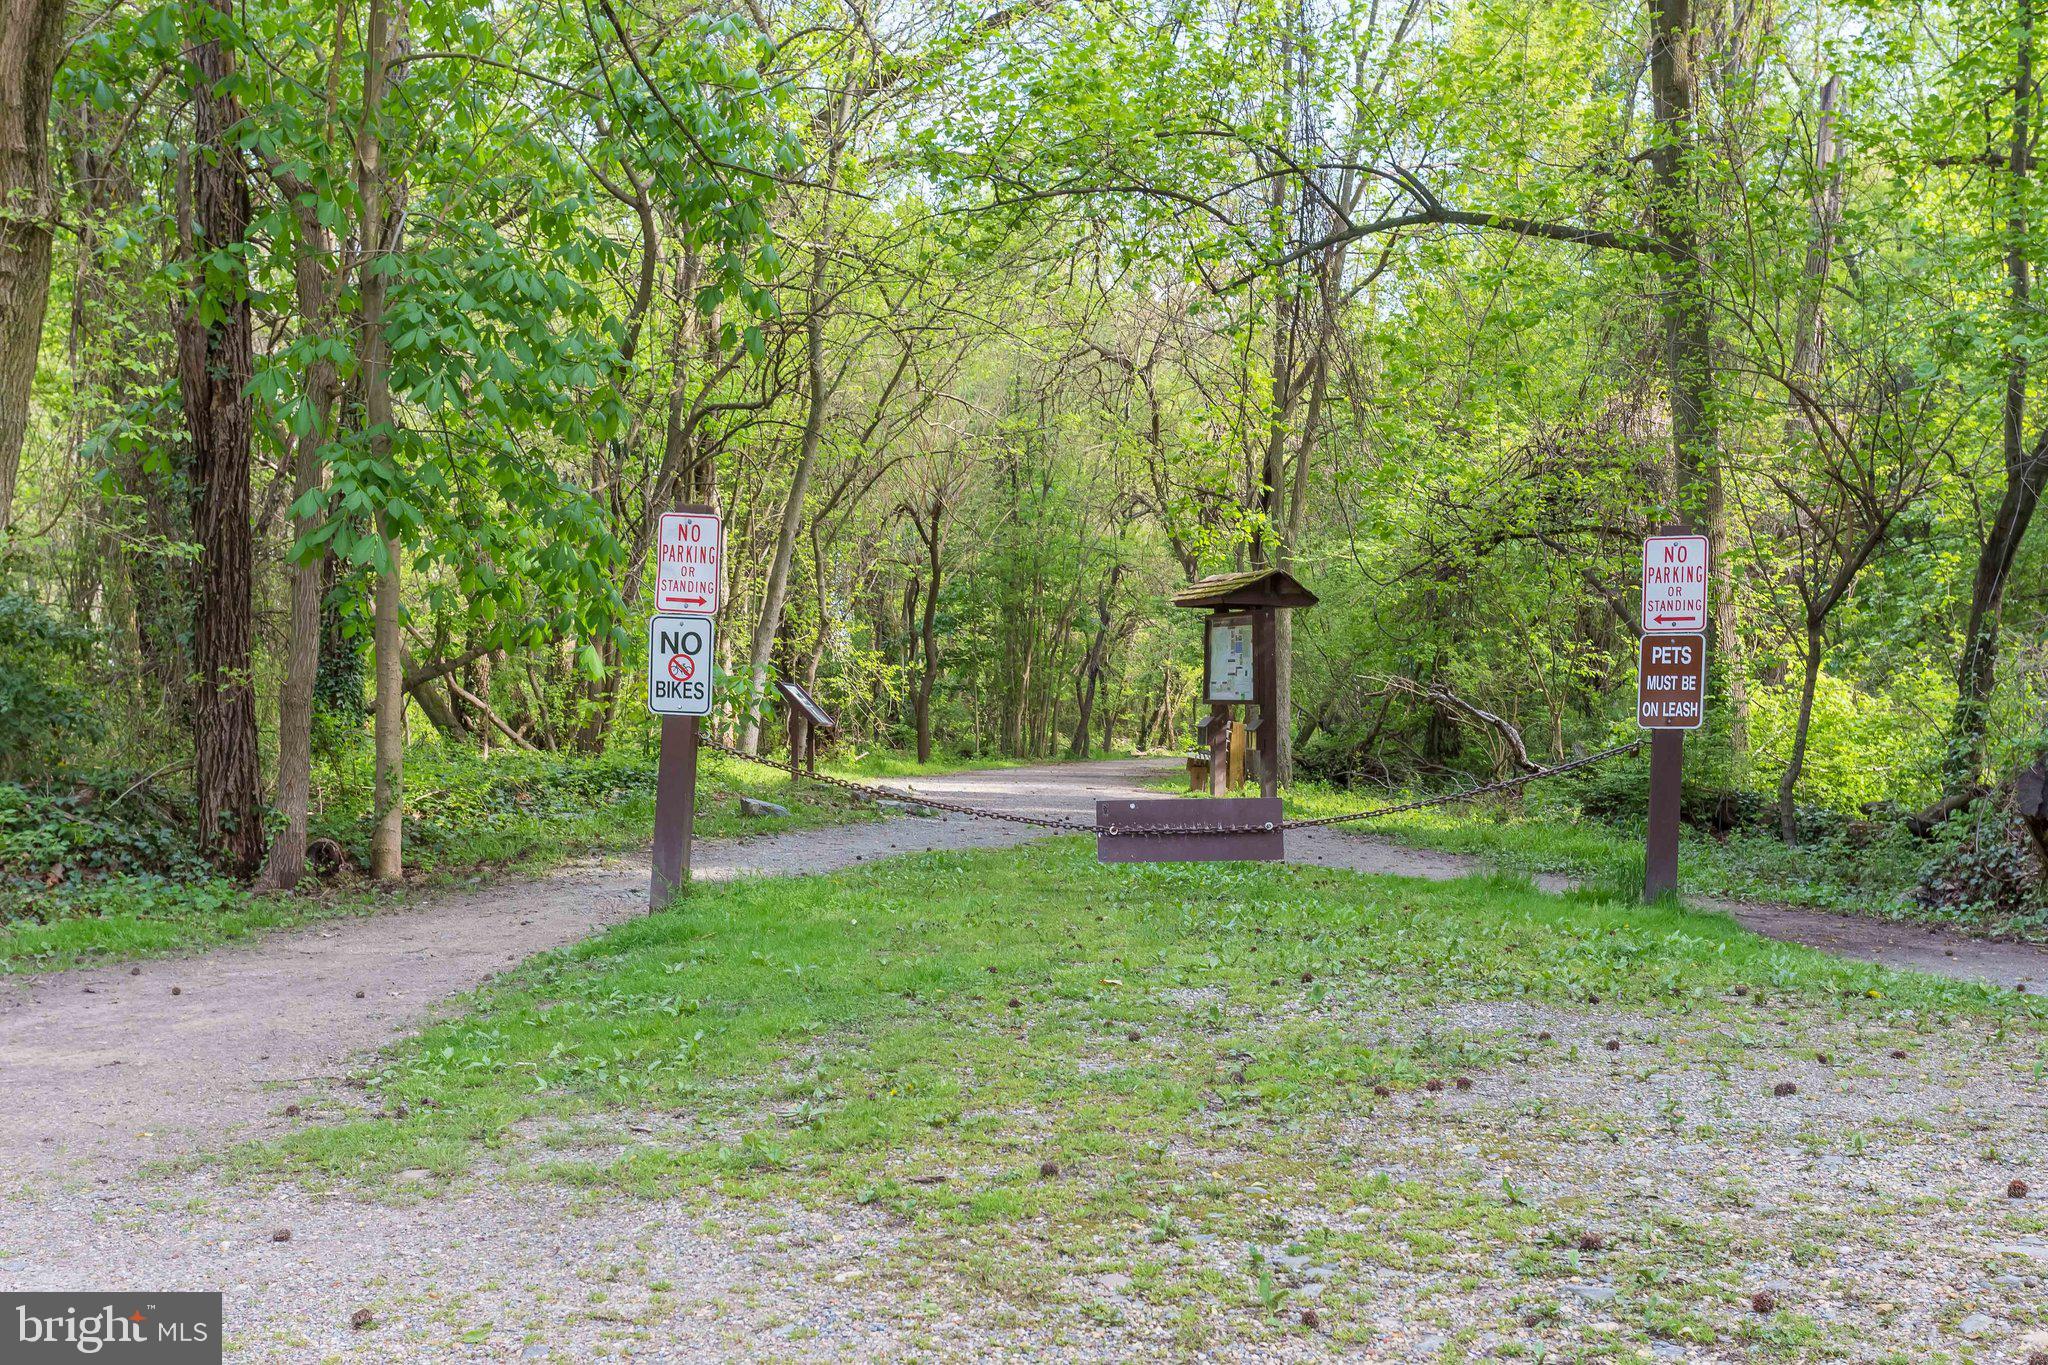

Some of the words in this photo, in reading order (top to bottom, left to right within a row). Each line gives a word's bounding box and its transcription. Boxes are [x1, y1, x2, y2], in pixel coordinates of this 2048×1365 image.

[678, 523, 701, 543] NO
[662, 544, 716, 565] PARKING
[1664, 545, 1688, 563] NO
[681, 565, 695, 578] OR
[1648, 565, 1703, 584] PARKING
[661, 579, 714, 595] STANDING
[1668, 586, 1682, 597] OR
[1647, 599, 1702, 612] STANDING
[660, 631, 703, 655] NO
[1651, 645, 1692, 665] PETS
[655, 680, 705, 700] BIKES
[1646, 675, 1678, 691] MUST
[1681, 675, 1697, 691] BE
[1642, 701, 1659, 717] ON
[1662, 701, 1698, 718] LEASH
